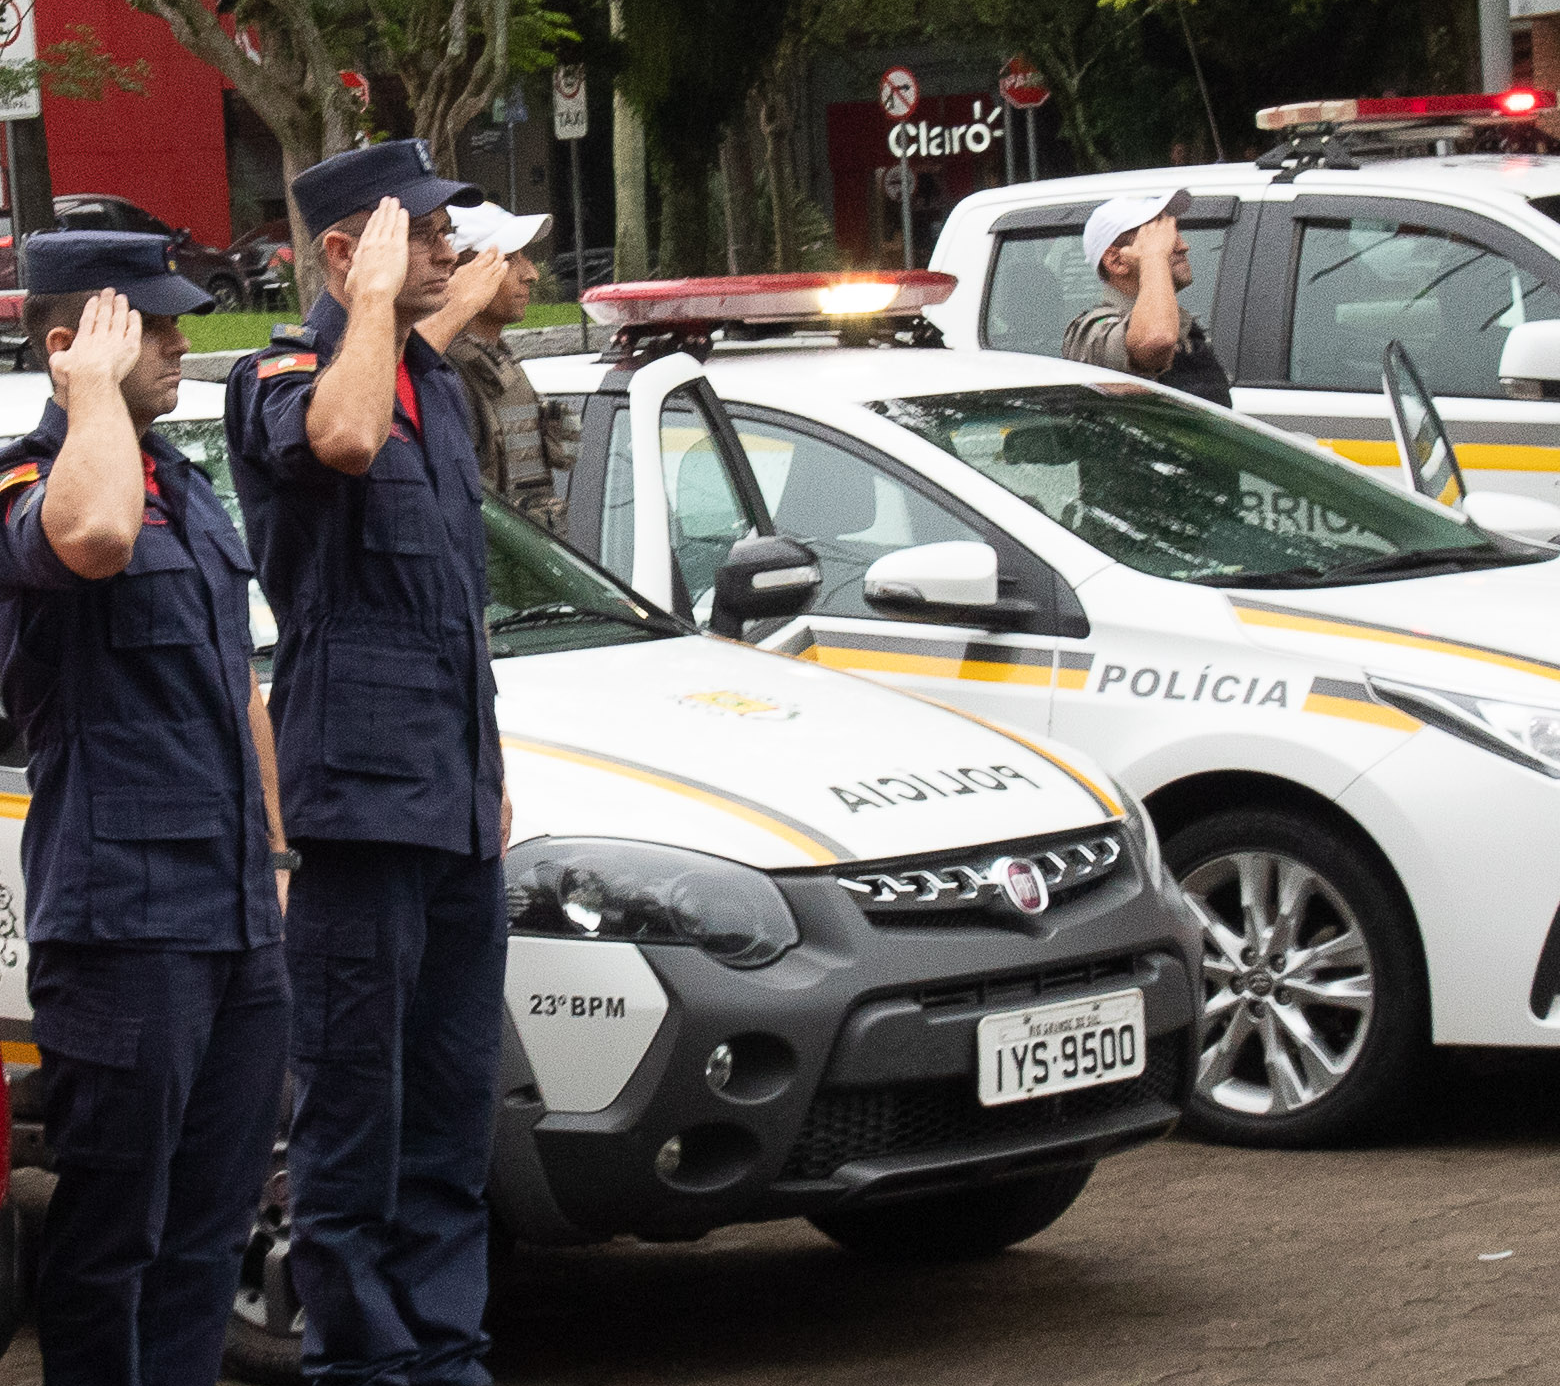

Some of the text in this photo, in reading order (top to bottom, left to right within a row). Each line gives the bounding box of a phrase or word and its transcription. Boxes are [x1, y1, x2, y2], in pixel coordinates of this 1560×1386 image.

[888, 120, 992, 157] Claro
[1097, 664, 1288, 708] POLÍCIA
[571, 995, 625, 1018] BPM
